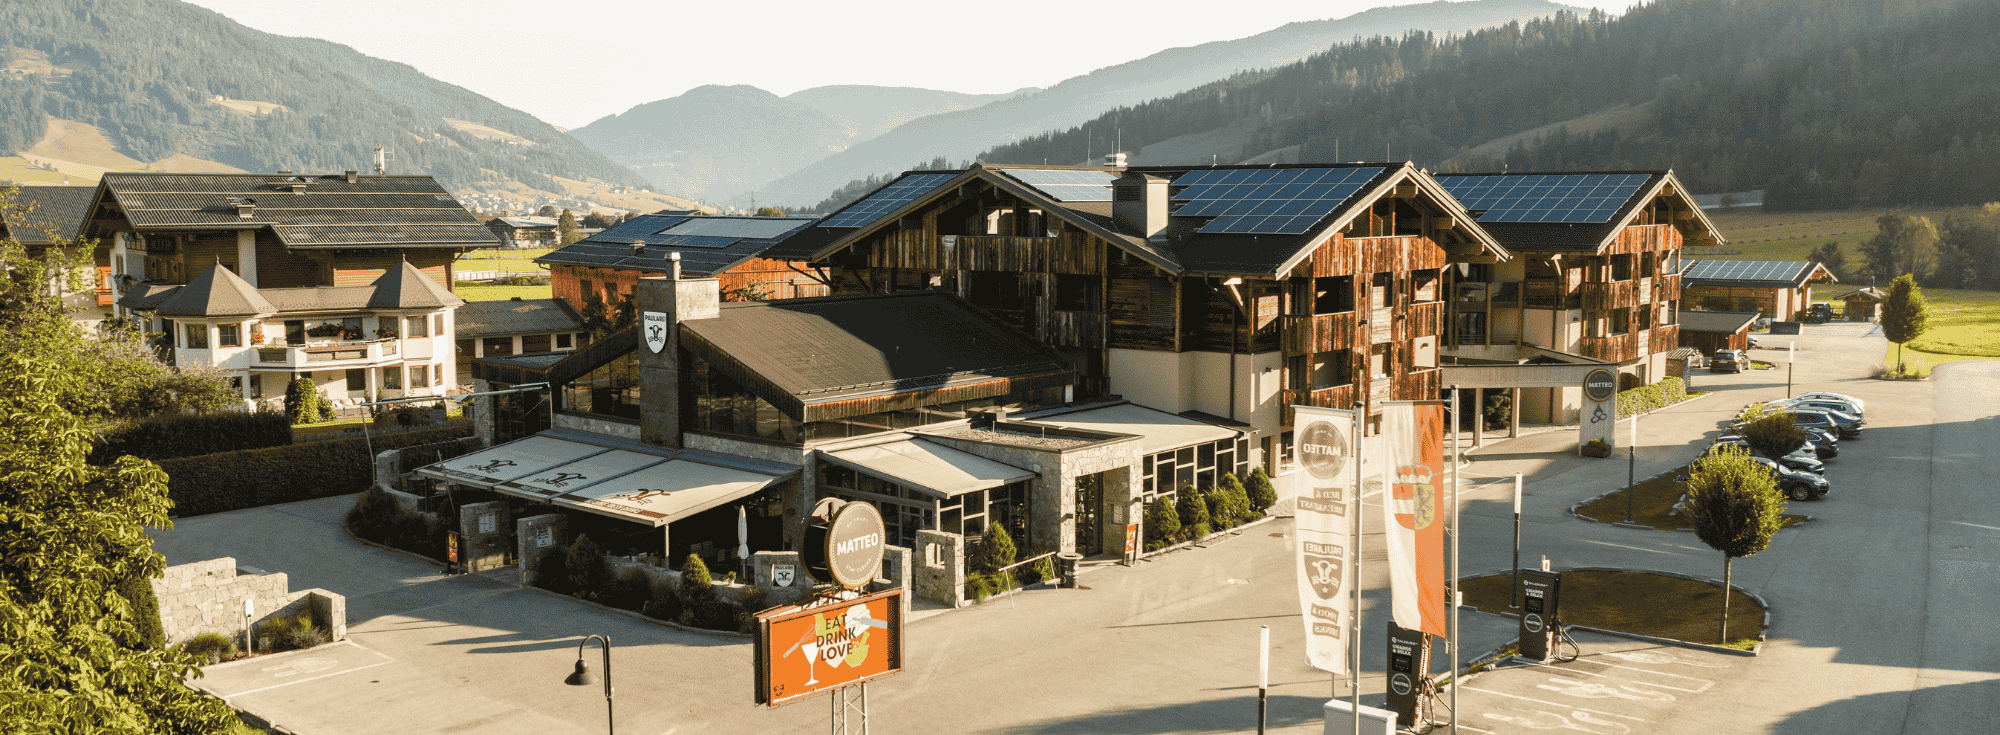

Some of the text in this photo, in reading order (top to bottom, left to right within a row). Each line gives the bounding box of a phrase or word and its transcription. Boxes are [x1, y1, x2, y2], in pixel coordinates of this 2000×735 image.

[837, 532, 879, 556] MATTEO
[826, 614, 847, 630] EAT
[816, 627, 856, 648] DRINK
[820, 643, 853, 661] LOVE
